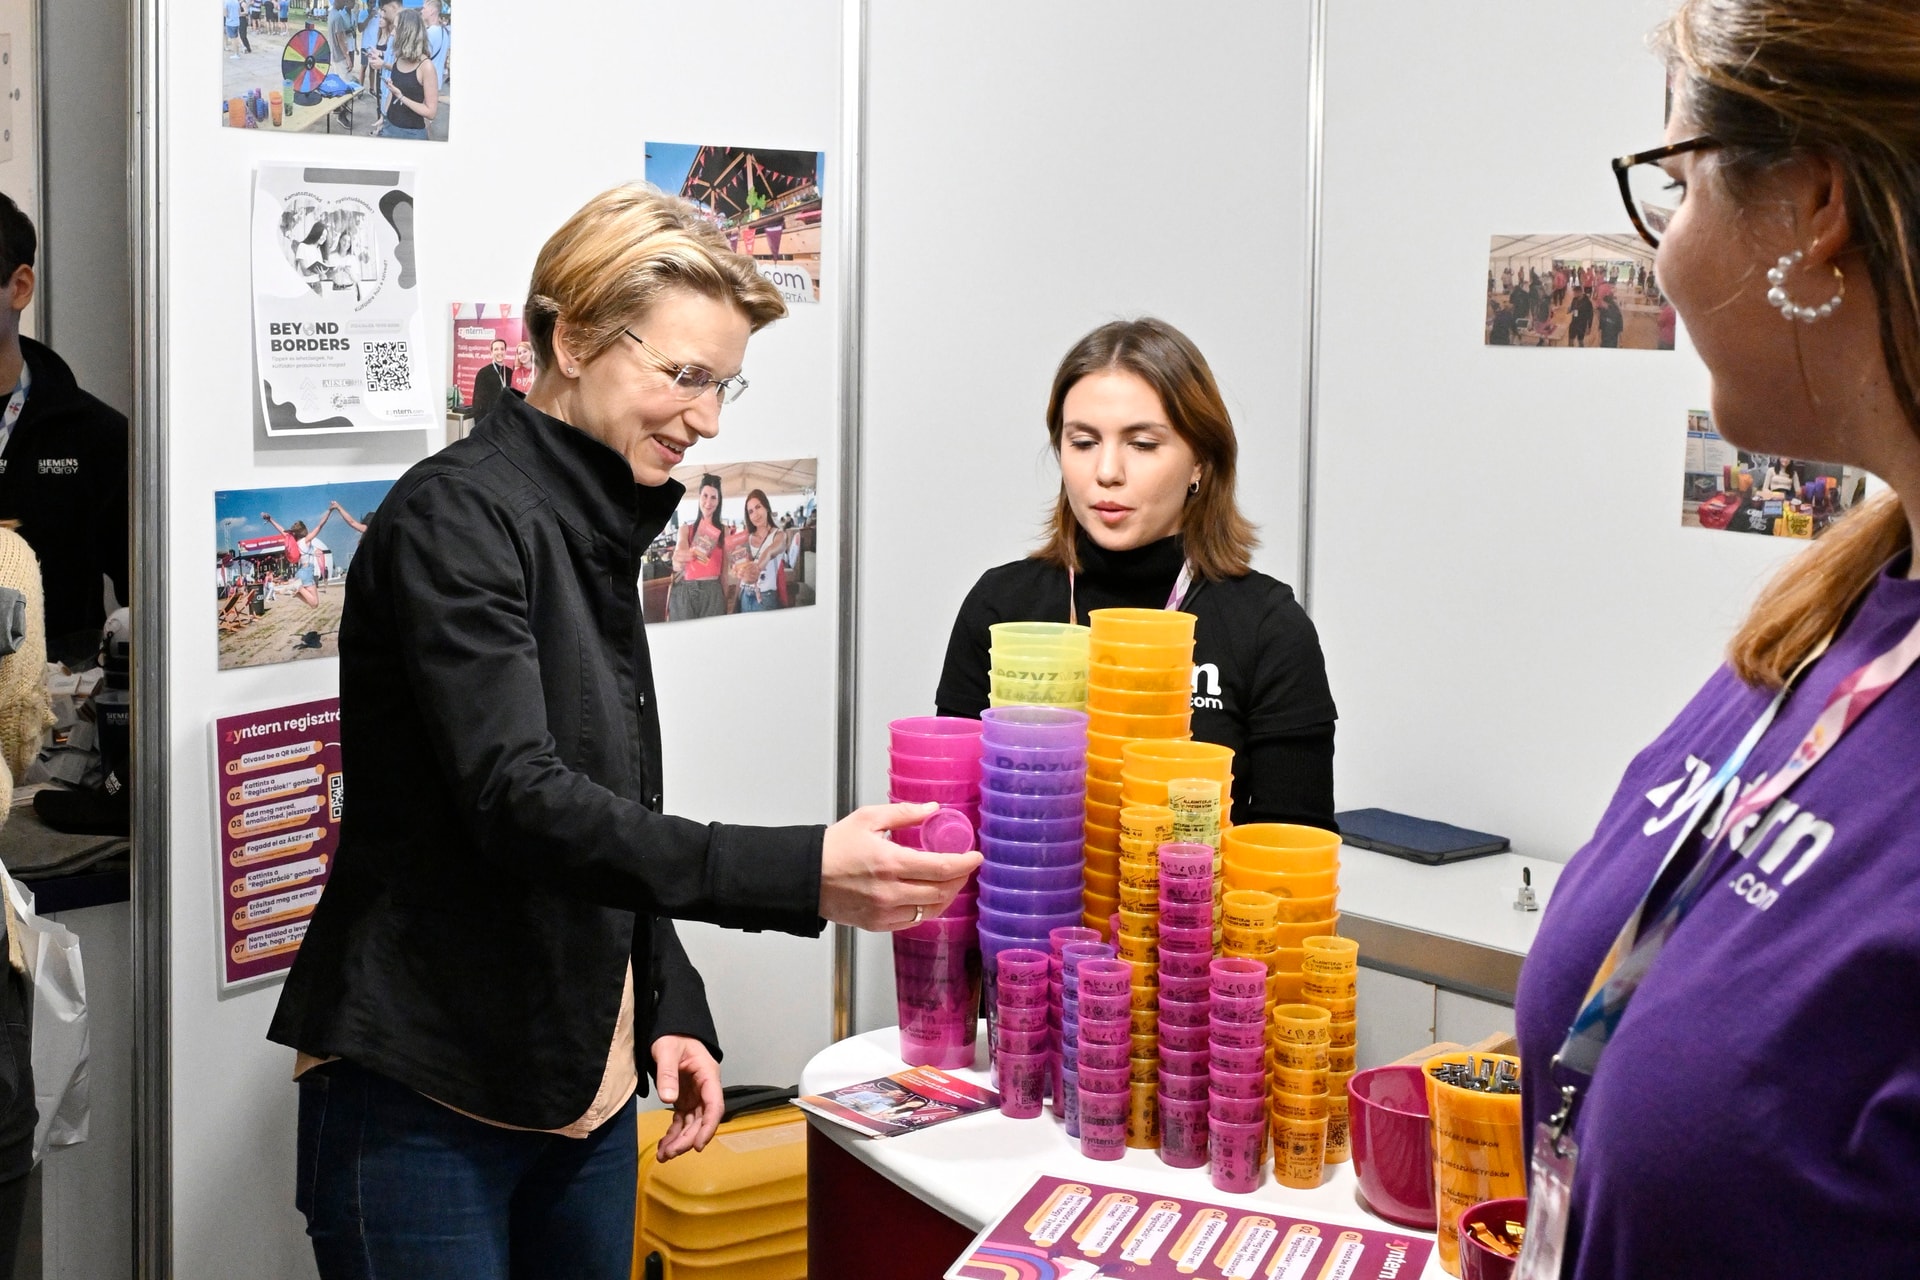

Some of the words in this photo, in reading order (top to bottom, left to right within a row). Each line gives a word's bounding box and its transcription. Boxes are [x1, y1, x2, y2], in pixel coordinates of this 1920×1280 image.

[271, 338, 350, 352] BORDERS
[38, 458, 79, 467] SIEMENS
[1190, 696, 1223, 710] om
[106, 712, 130, 720] SIEME
[225, 721, 282, 744] zyntern
[284, 708, 341, 731] regisztrá
[243, 755, 266, 764] Olvasd
[229, 763, 238, 772] 01
[244, 780, 270, 790] Kattints
[292, 776, 320, 789] gombra!
[229, 791, 241, 801] 02
[245, 809, 259, 819] Add
[259, 808, 275, 818] meg
[231, 819, 242, 829] 03
[247, 842, 271, 853] Fogadd
[272, 840, 278, 848] el
[232, 850, 244, 859] 04
[247, 871, 273, 881] Kattints
[294, 866, 321, 880] gombra!
[232, 884, 245, 893] 05
[276, 897, 291, 906] meg
[299, 889, 317, 898] email
[234, 911, 246, 920] 06
[249, 935, 264, 943] Nem
[234, 944, 245, 954] 07
[1119, 1195, 1133, 1203] 06
[1160, 1201, 1174, 1210] 05
[1210, 1211, 1223, 1219] 04
[1256, 1218, 1270, 1226] 03
[1298, 1225, 1313, 1233] 02
